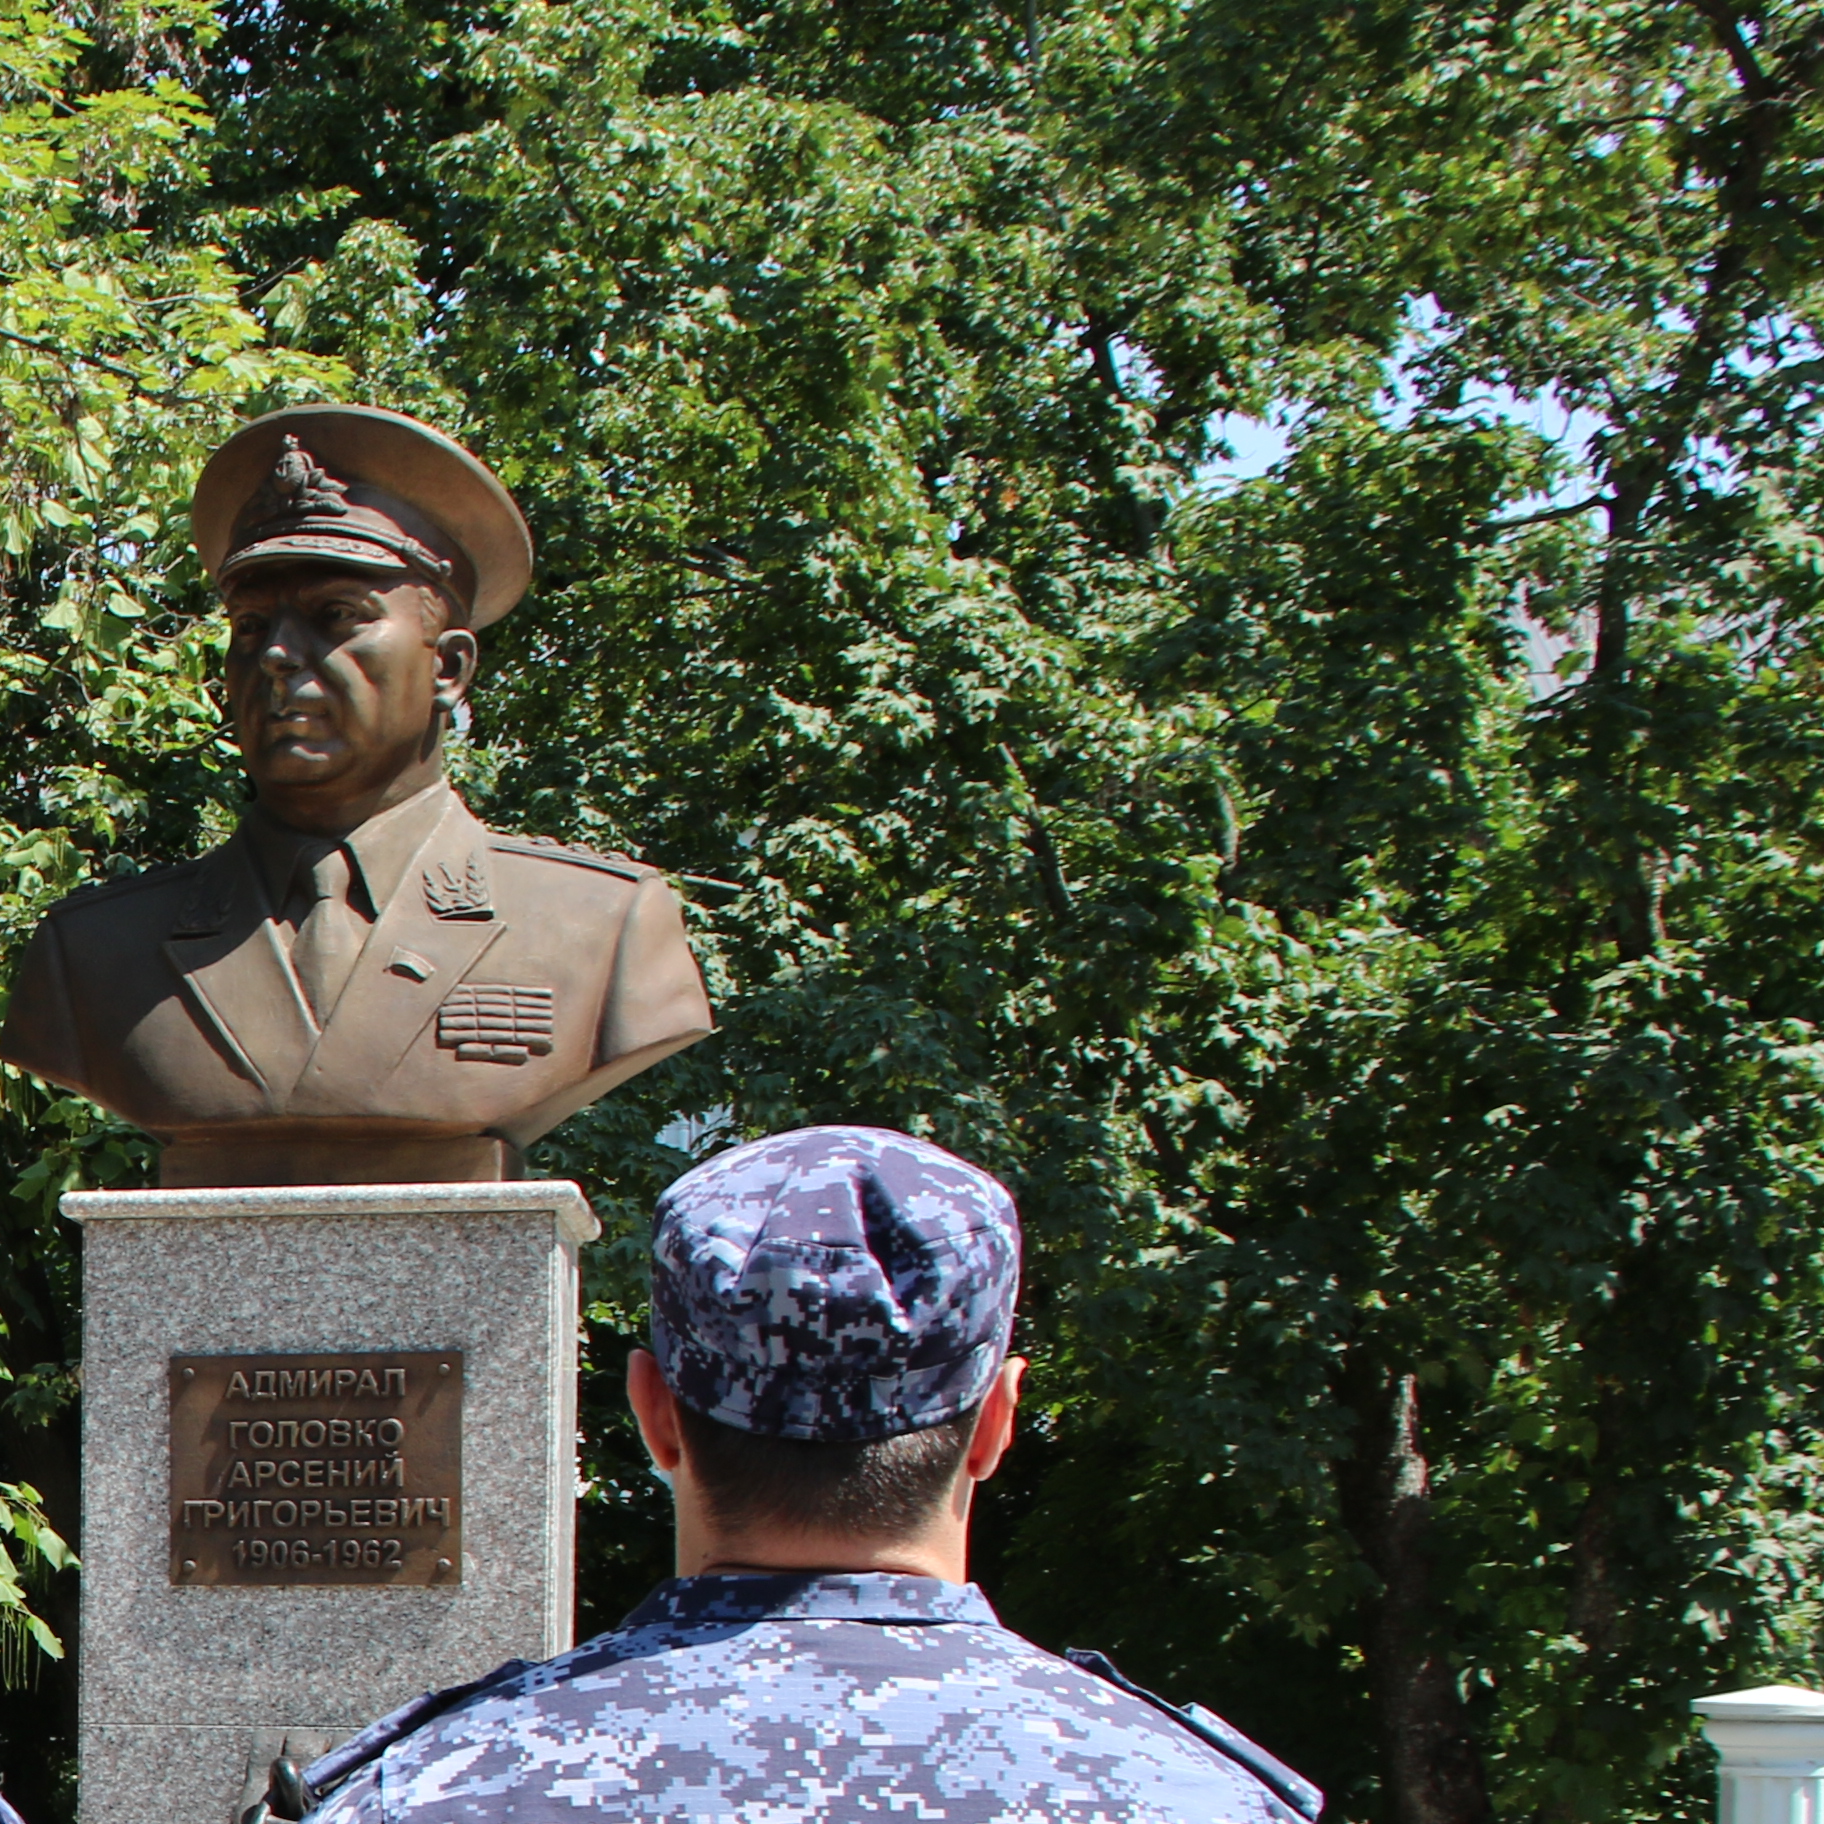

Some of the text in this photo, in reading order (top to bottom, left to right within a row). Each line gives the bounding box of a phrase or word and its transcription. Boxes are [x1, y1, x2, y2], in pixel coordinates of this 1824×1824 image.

[225, 1368, 406, 1401] АДМИРАЛ
[229, 1418, 405, 1449] ГОЛОВКО
[228, 1451, 404, 1489] АРСЕНИЙ
[183, 1497, 450, 1529] ГРИГОРЬЕВИЧ
[232, 1539, 403, 1570] 1906-1962
